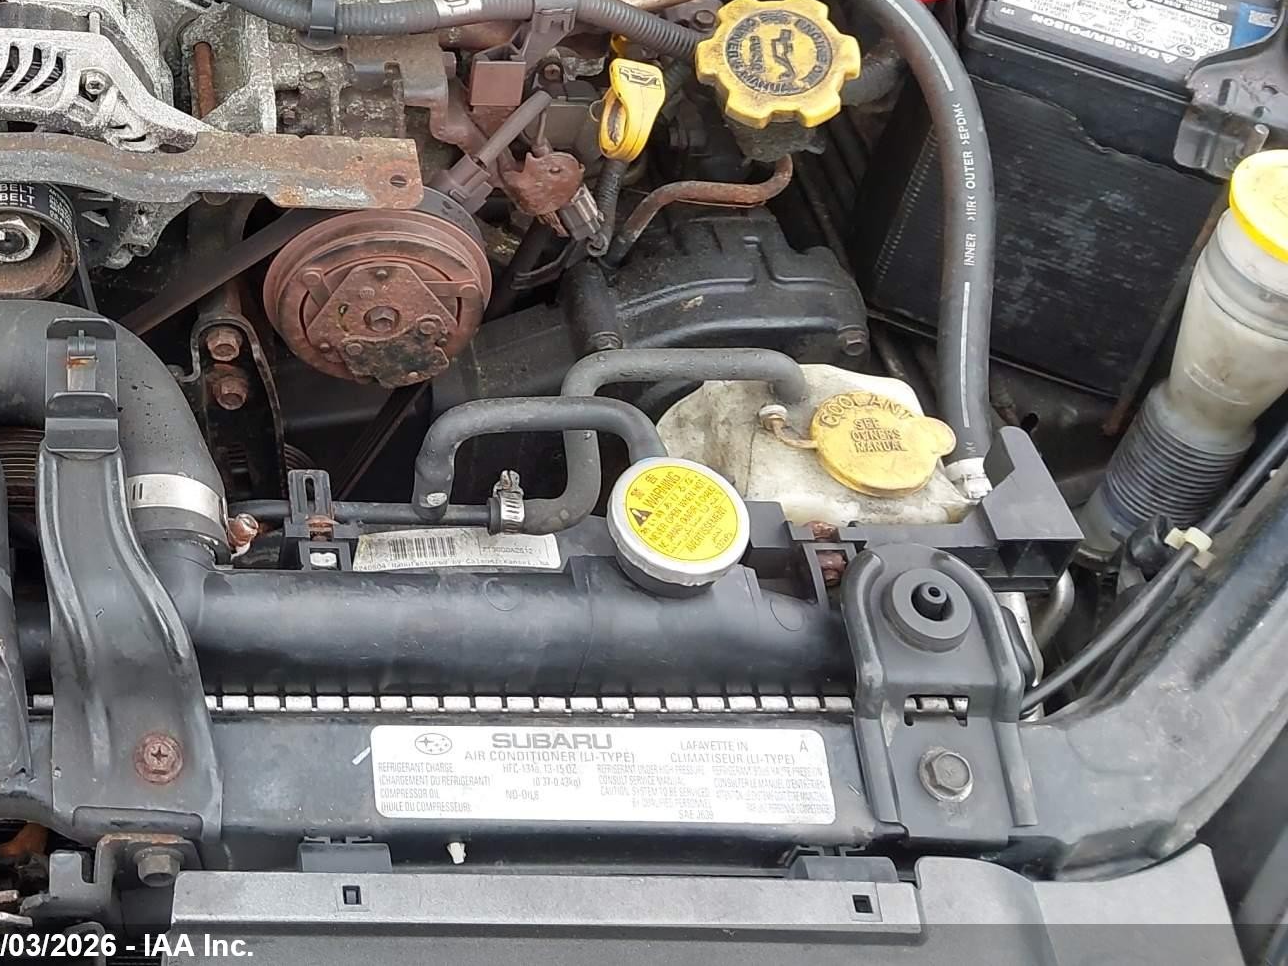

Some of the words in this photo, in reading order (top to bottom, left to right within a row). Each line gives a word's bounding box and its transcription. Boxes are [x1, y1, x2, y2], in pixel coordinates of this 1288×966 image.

[964, 150, 976, 188] OUTER
[0, 182, 35, 195] BELT
[0, 193, 35, 205] BELT
[963, 233, 976, 265] INNER
[820, 392, 914, 427] COOLANT
[853, 417, 881, 430] SEE
[854, 441, 909, 453] MANUAL
[644, 470, 680, 509] WARNING
[491, 732, 613, 750] SUBARU
[680, 740, 735, 751] LAFAYETTE
[737, 740, 749, 751] IN
[799, 739, 809, 753] A
[464, 751, 486, 761] AIR
[490, 751, 576, 763] CONDITIONER
[580, 752, 635, 763] (LI-TYPE)
[670, 753, 744, 764] CLIMATISEUR
[747, 754, 796, 765] (LI-TYPE)
[678, 810, 694, 820] SAE
